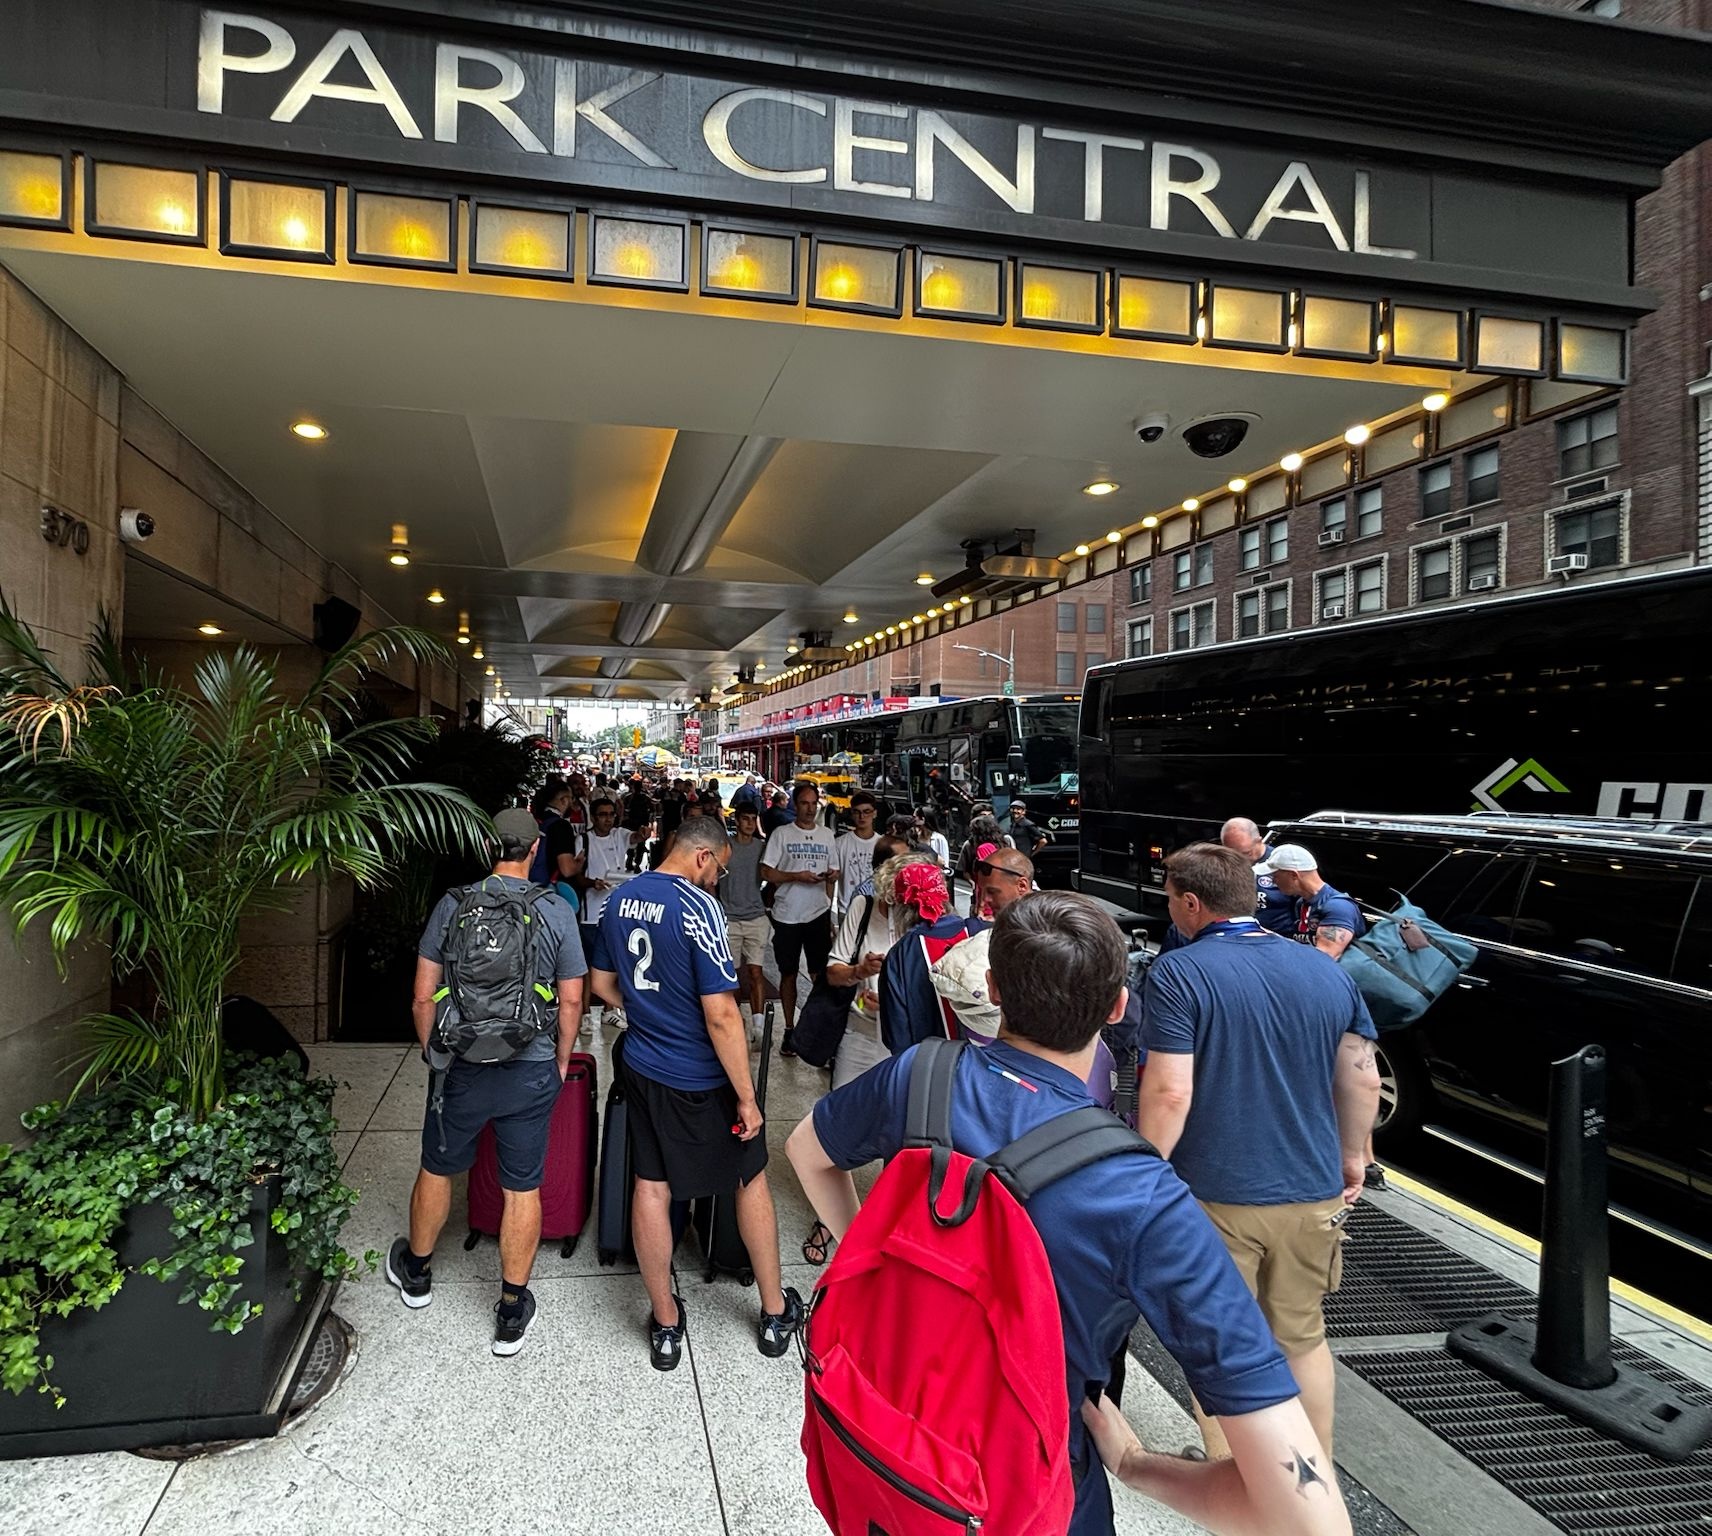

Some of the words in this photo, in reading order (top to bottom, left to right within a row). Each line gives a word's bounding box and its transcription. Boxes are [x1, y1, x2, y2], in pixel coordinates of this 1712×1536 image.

[197, 9, 678, 171] PARK
[702, 87, 1418, 260] CENTRAL
[41, 505, 90, 555] 370
[786, 843, 829, 854] COLUMBIA
[618, 898, 666, 925] HAKIMI
[628, 927, 660, 992] 2
